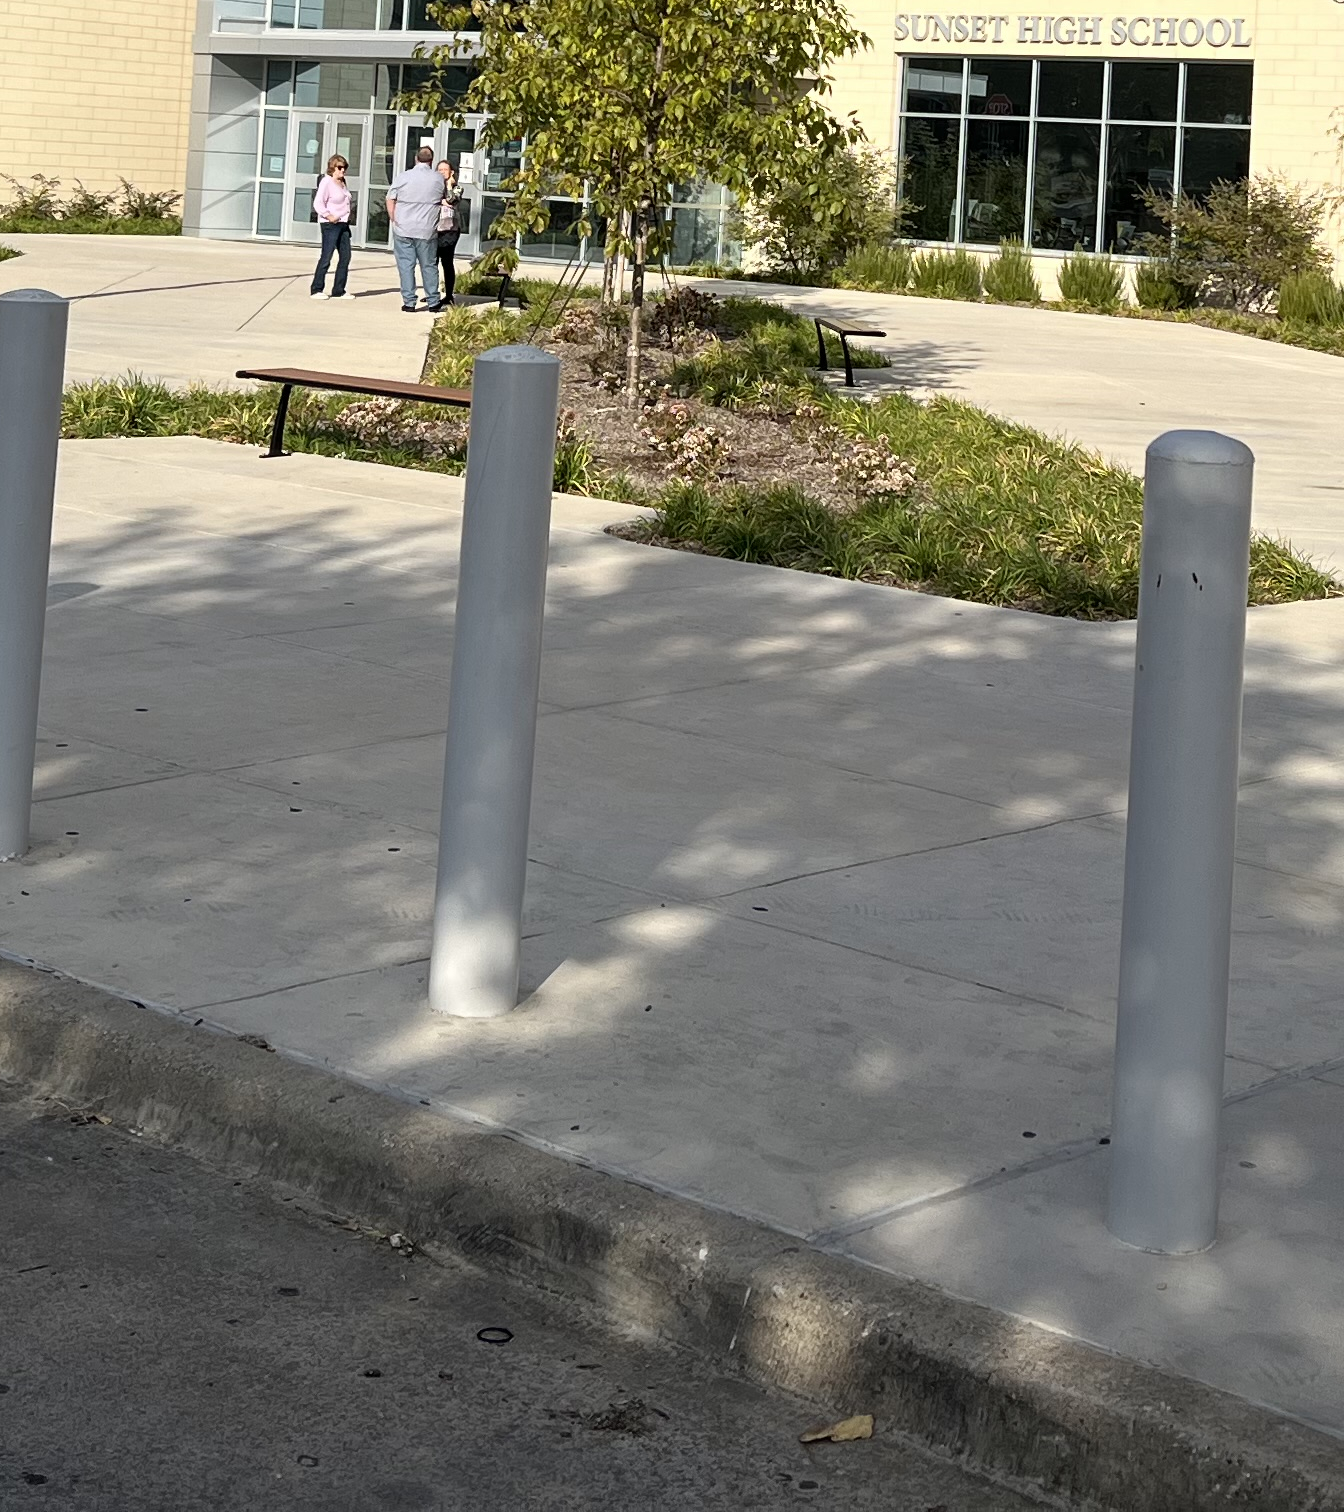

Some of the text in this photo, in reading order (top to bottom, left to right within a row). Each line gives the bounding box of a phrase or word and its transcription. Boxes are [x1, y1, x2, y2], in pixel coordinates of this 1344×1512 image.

[894, 14, 1252, 48] SUNSET HIGH SCHOOL
